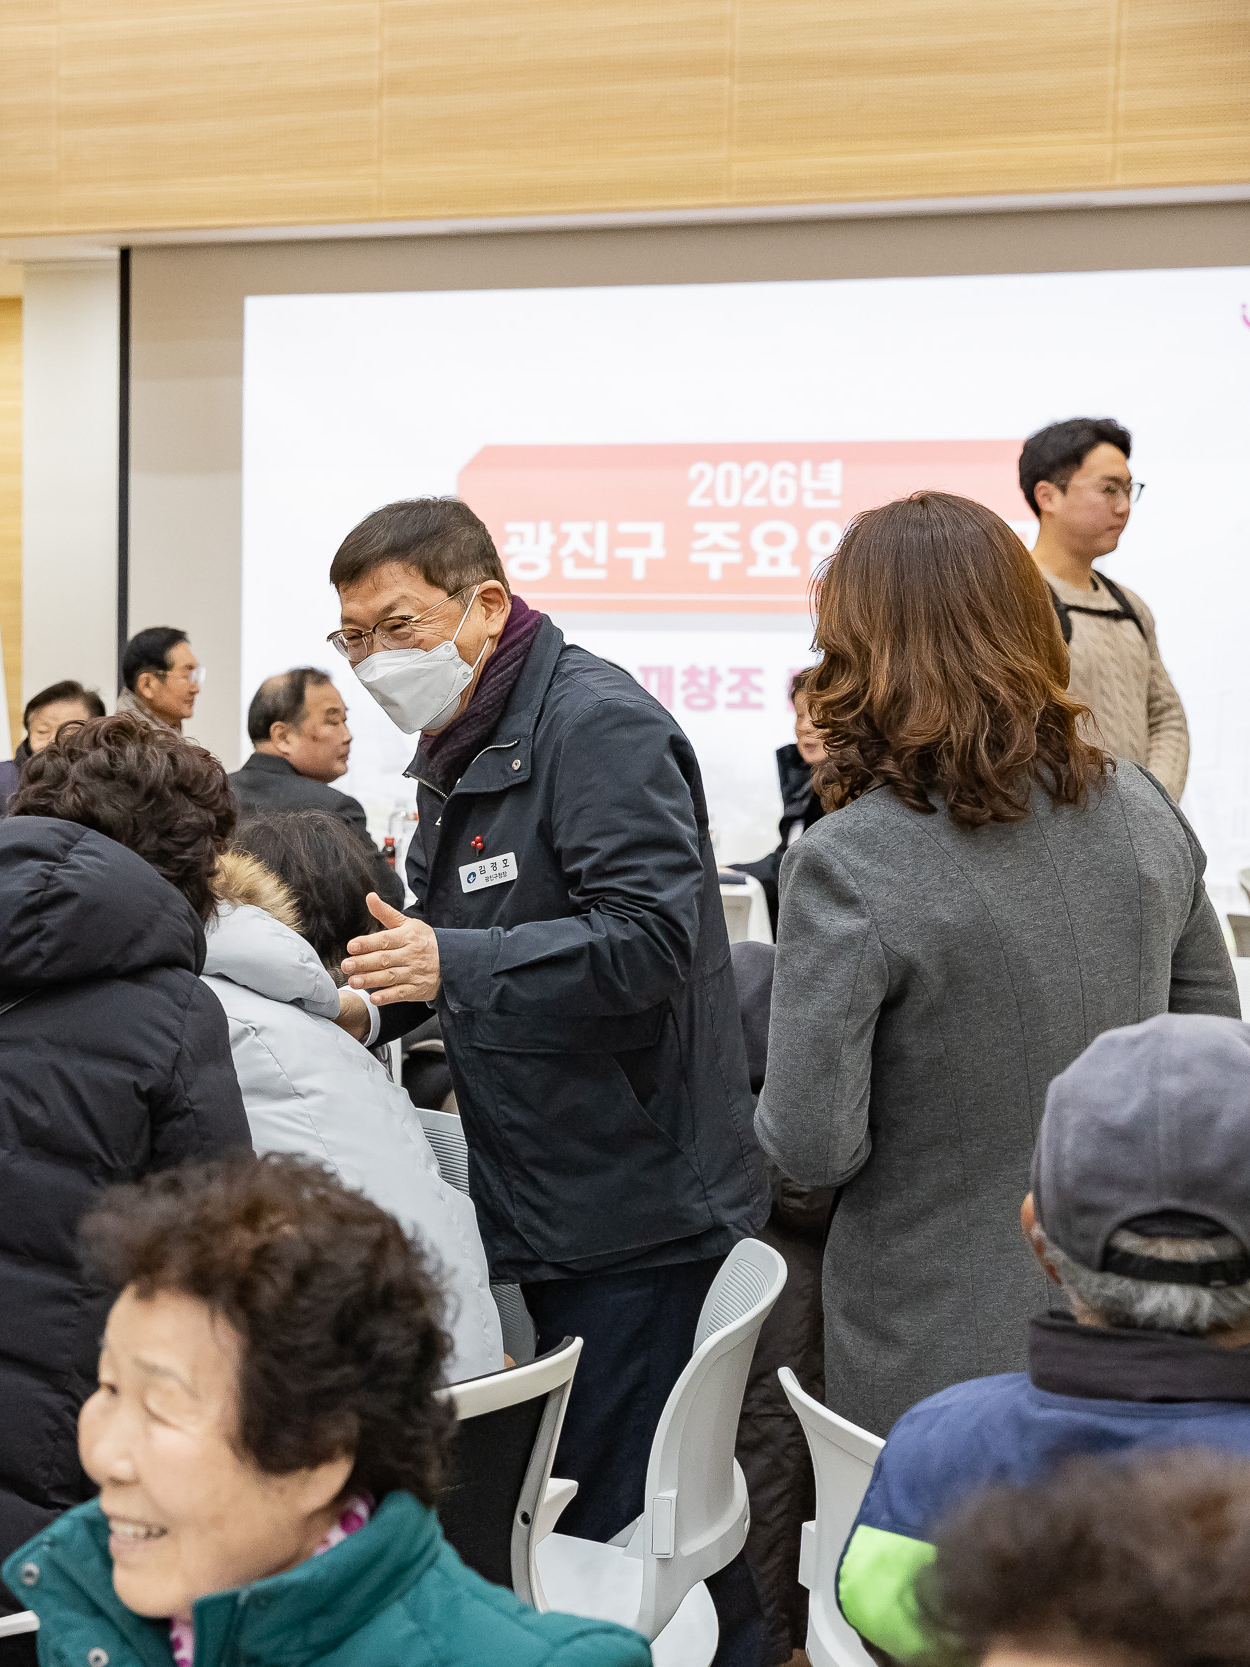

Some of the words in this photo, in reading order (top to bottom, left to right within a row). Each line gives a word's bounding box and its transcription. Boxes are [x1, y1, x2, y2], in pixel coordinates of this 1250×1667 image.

[687, 459, 844, 509] 2026년
[502, 519, 666, 581] 광진구
[478, 858, 510, 875] 김경호
